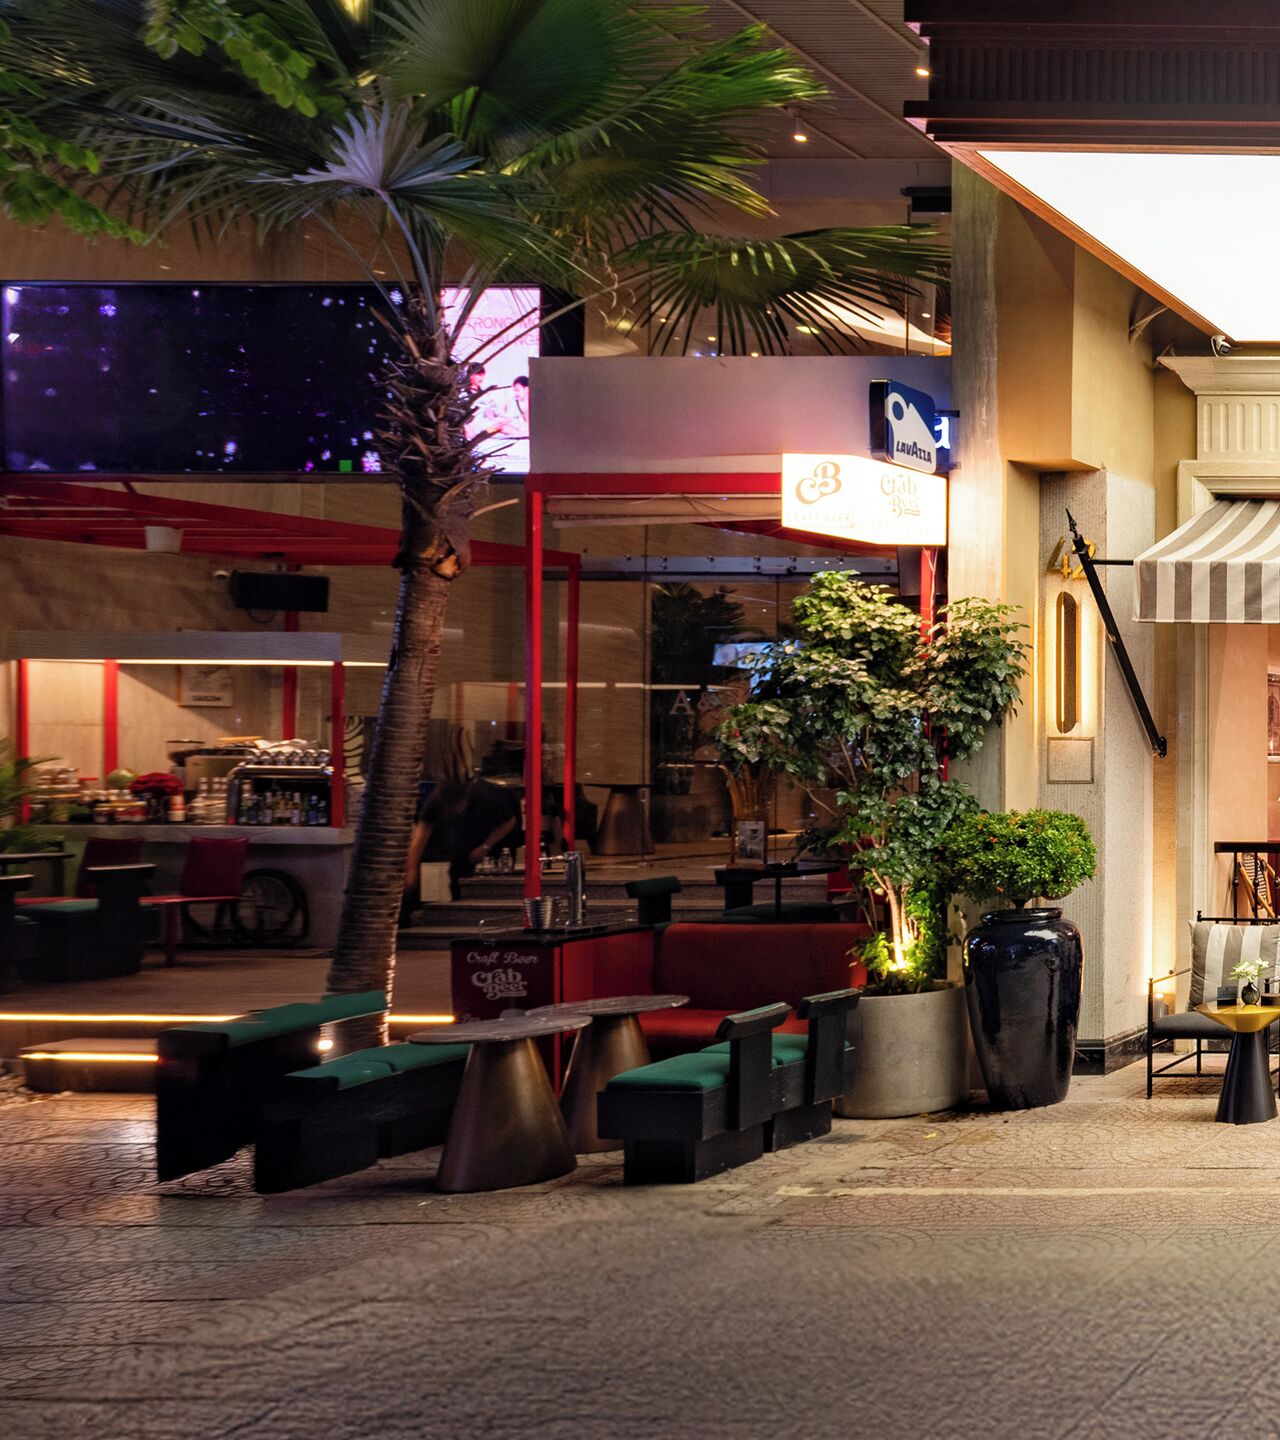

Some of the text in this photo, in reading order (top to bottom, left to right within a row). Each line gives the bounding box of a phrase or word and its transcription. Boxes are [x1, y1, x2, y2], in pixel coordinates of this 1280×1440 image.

[896, 441, 932, 464] LAVAZZA
[466, 951, 538, 966] Craft Beer
[471, 968, 522, 988] Crab
[482, 981, 528, 1000] Beer
